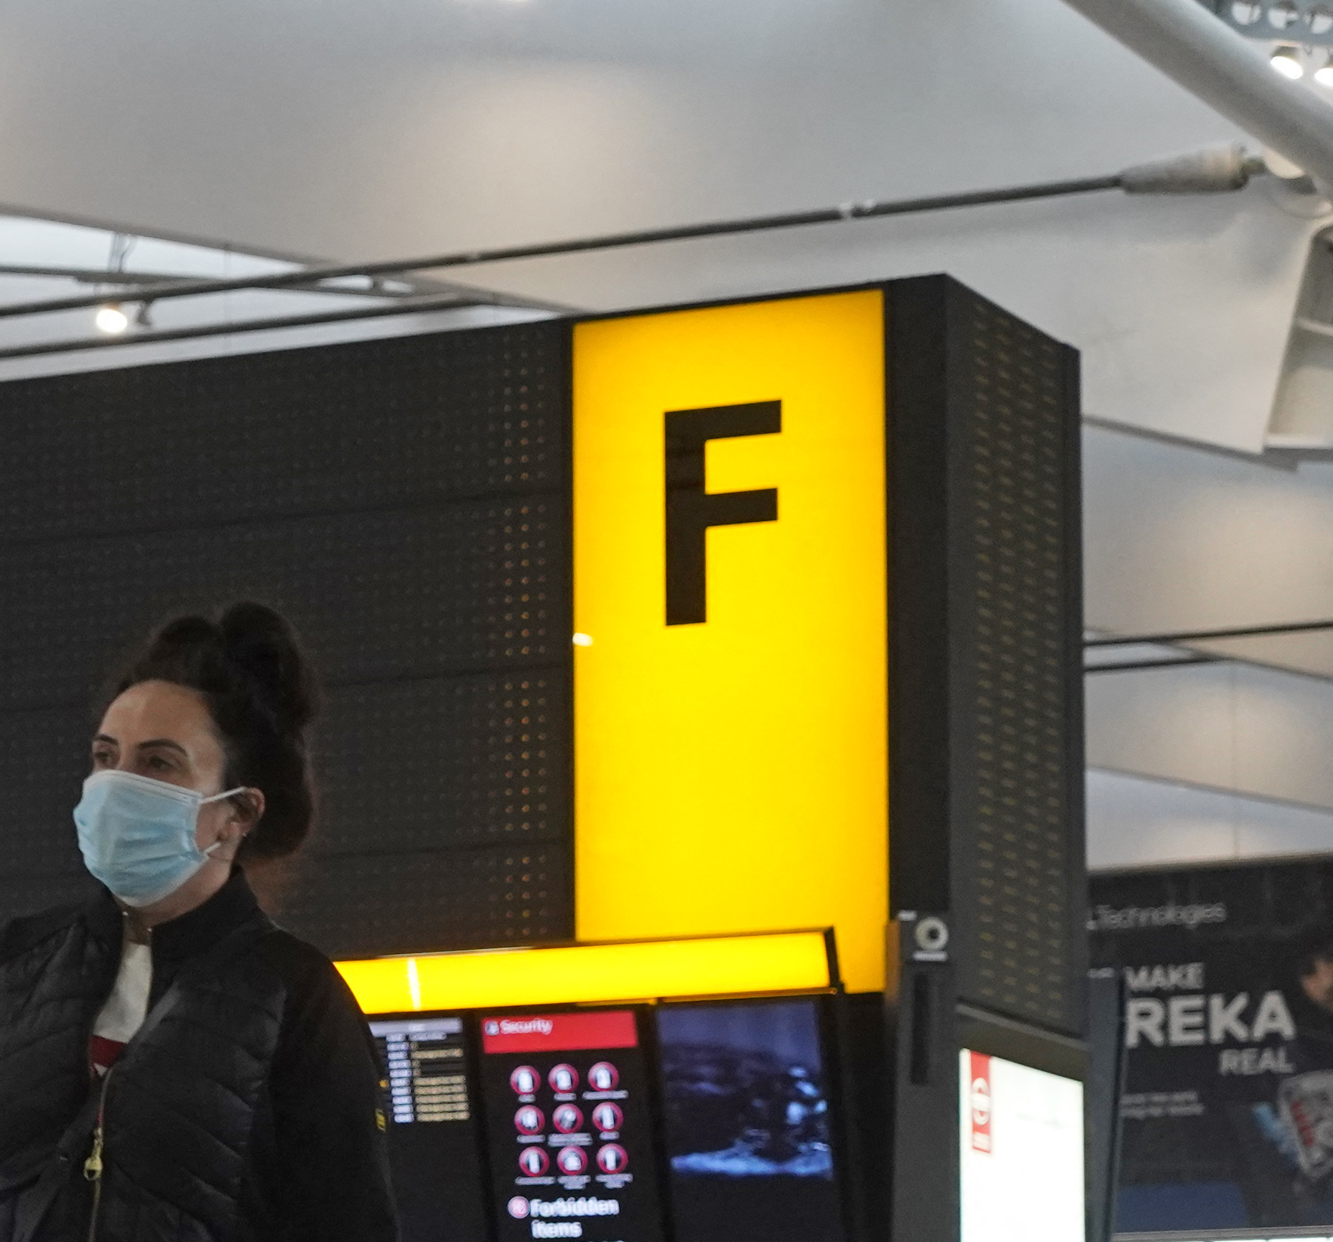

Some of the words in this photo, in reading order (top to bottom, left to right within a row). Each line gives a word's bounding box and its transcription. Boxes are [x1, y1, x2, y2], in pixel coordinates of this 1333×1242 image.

[663, 399, 782, 627] F
[1095, 903, 1227, 929] Technologies
[1123, 962, 1205, 992] MAKE
[499, 1017, 554, 1035] Security
[1125, 990, 1297, 1050] REKA
[1217, 1047, 1297, 1077] REAL
